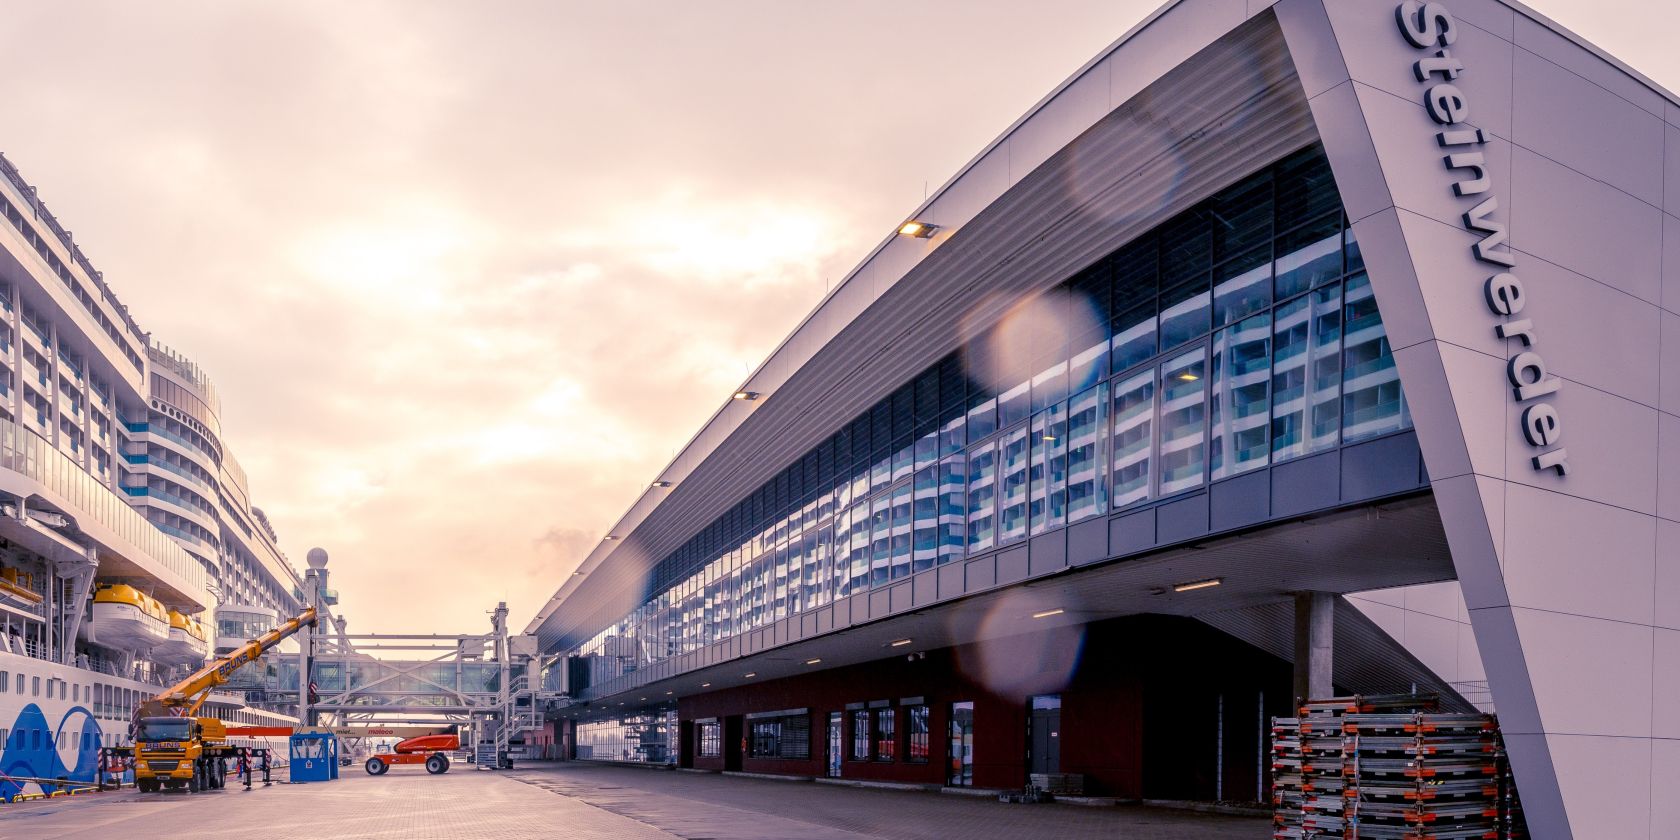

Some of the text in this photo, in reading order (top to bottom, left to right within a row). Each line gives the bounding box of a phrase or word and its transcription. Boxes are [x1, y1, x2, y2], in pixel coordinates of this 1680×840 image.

[1395, 2, 1571, 477] Steinwerder
[218, 653, 249, 675] BRUNS
[145, 742, 181, 750] BRUNS
